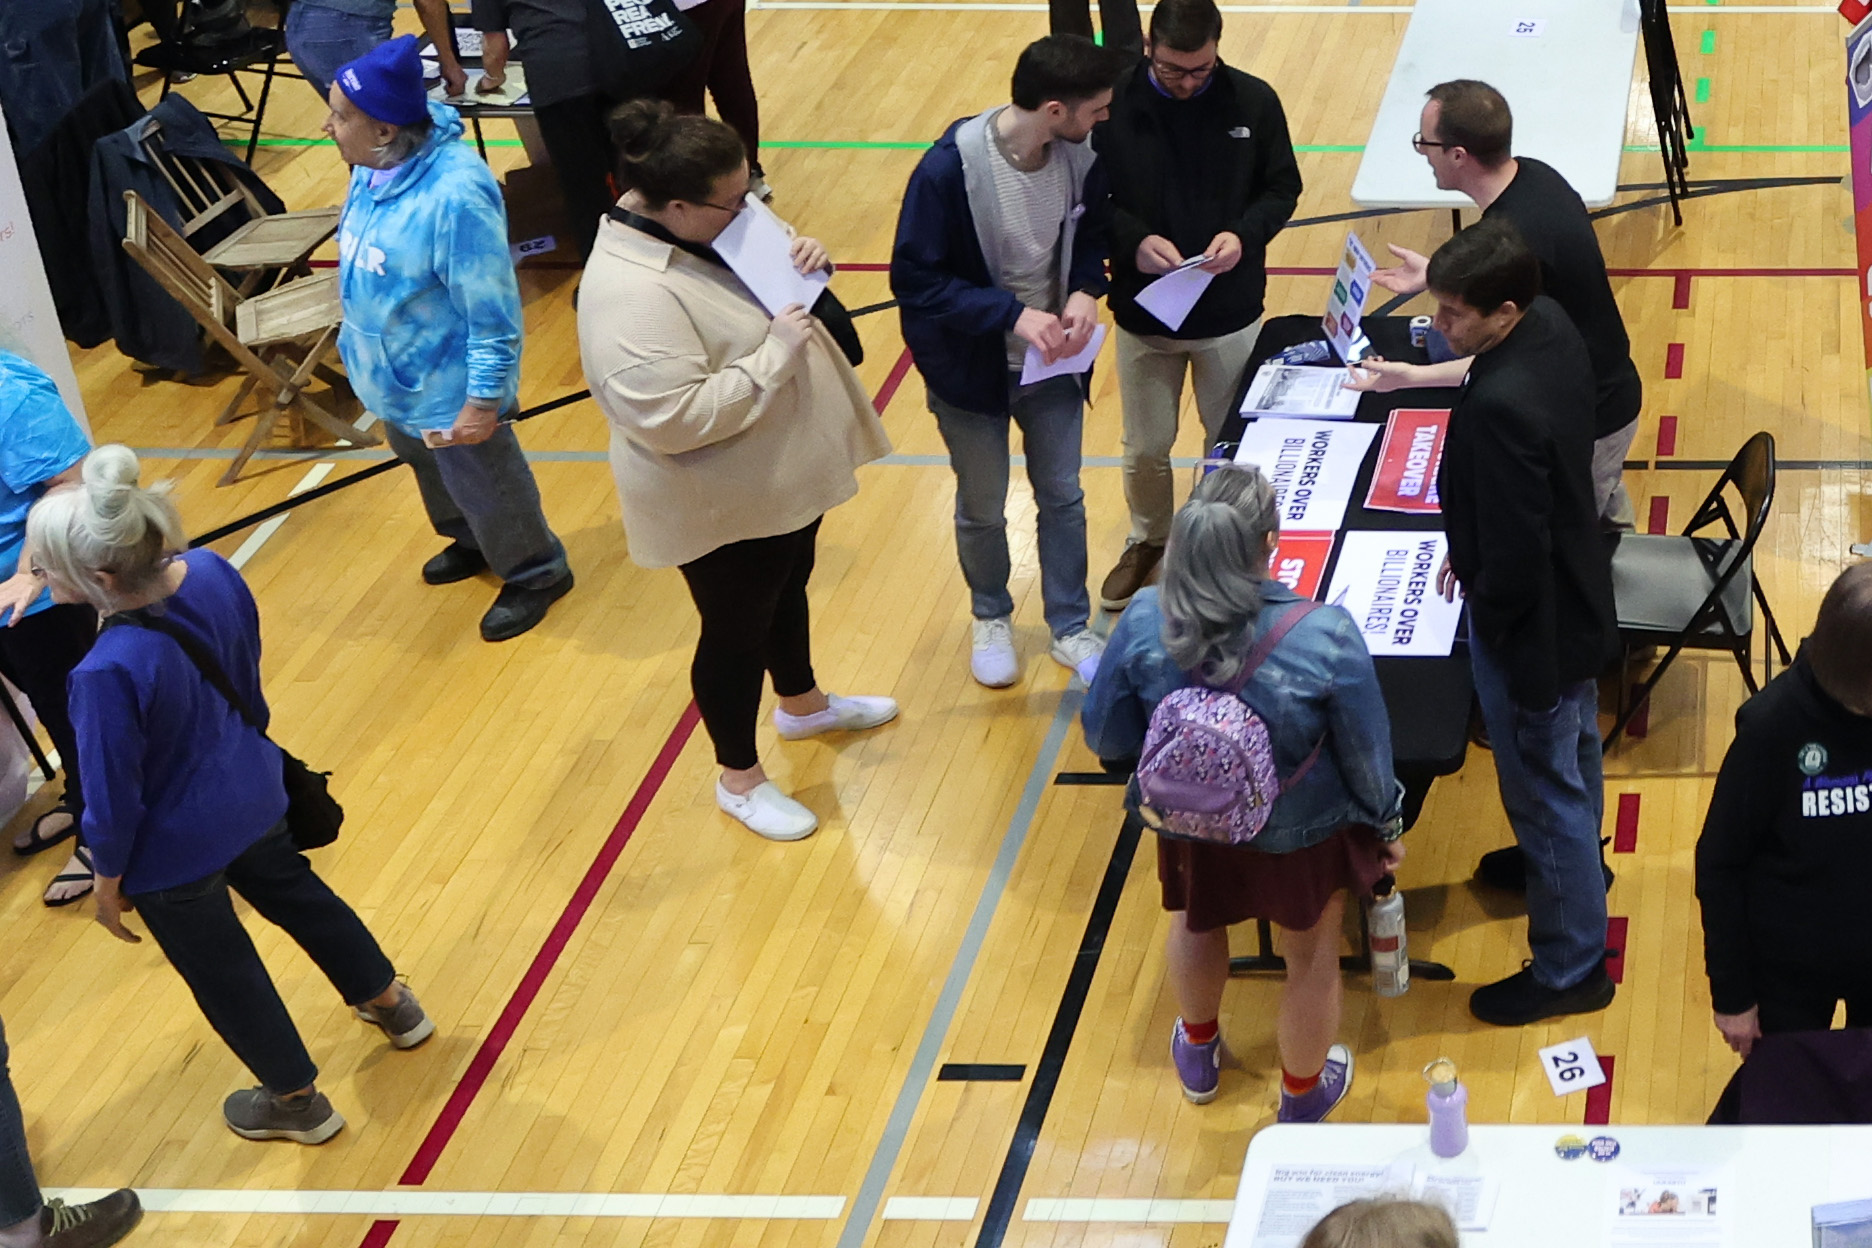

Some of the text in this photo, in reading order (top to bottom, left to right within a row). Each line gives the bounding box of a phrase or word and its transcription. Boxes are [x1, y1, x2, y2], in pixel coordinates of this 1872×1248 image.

[612, 5, 652, 25] REA
[1516, 21, 1536, 34] 25
[1286, 429, 1334, 522] WORKERS OVER
[1397, 424, 1438, 498] TAKEOVER
[1277, 557, 1305, 592] STO
[1391, 539, 1438, 646] WORKERS OVER
[1550, 1050, 1586, 1084] 26
